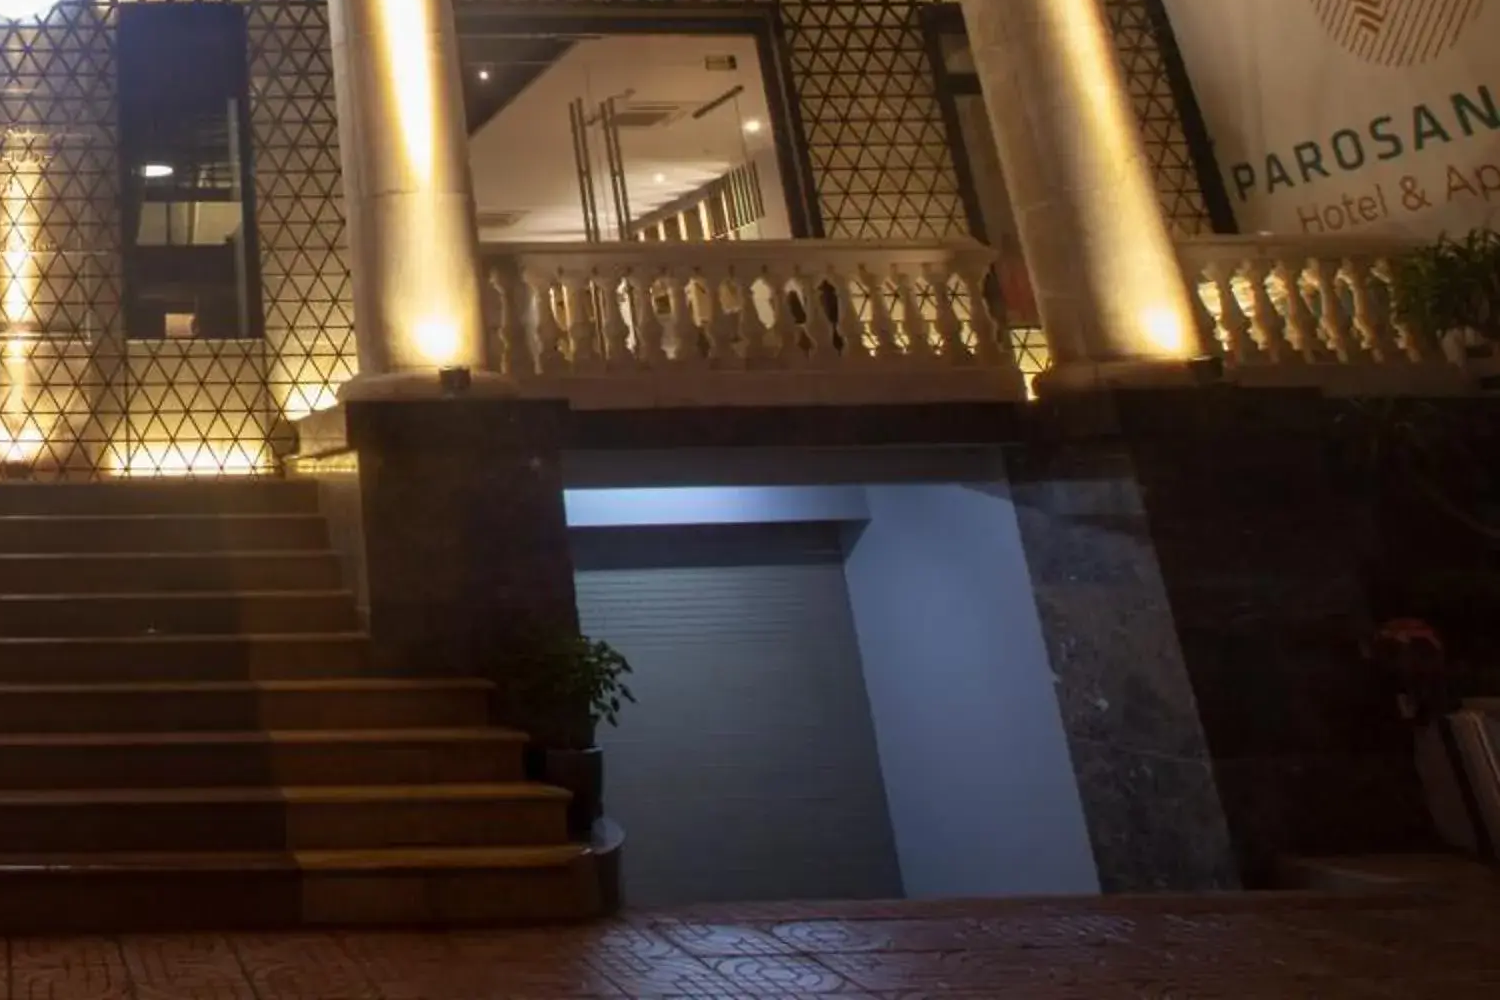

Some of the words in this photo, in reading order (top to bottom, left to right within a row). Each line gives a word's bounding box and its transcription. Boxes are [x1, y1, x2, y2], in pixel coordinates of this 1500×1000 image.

[1230, 84, 1500, 202] PAROSAN
[1297, 182, 1389, 234] Hotel
[1398, 174, 1433, 212] &
